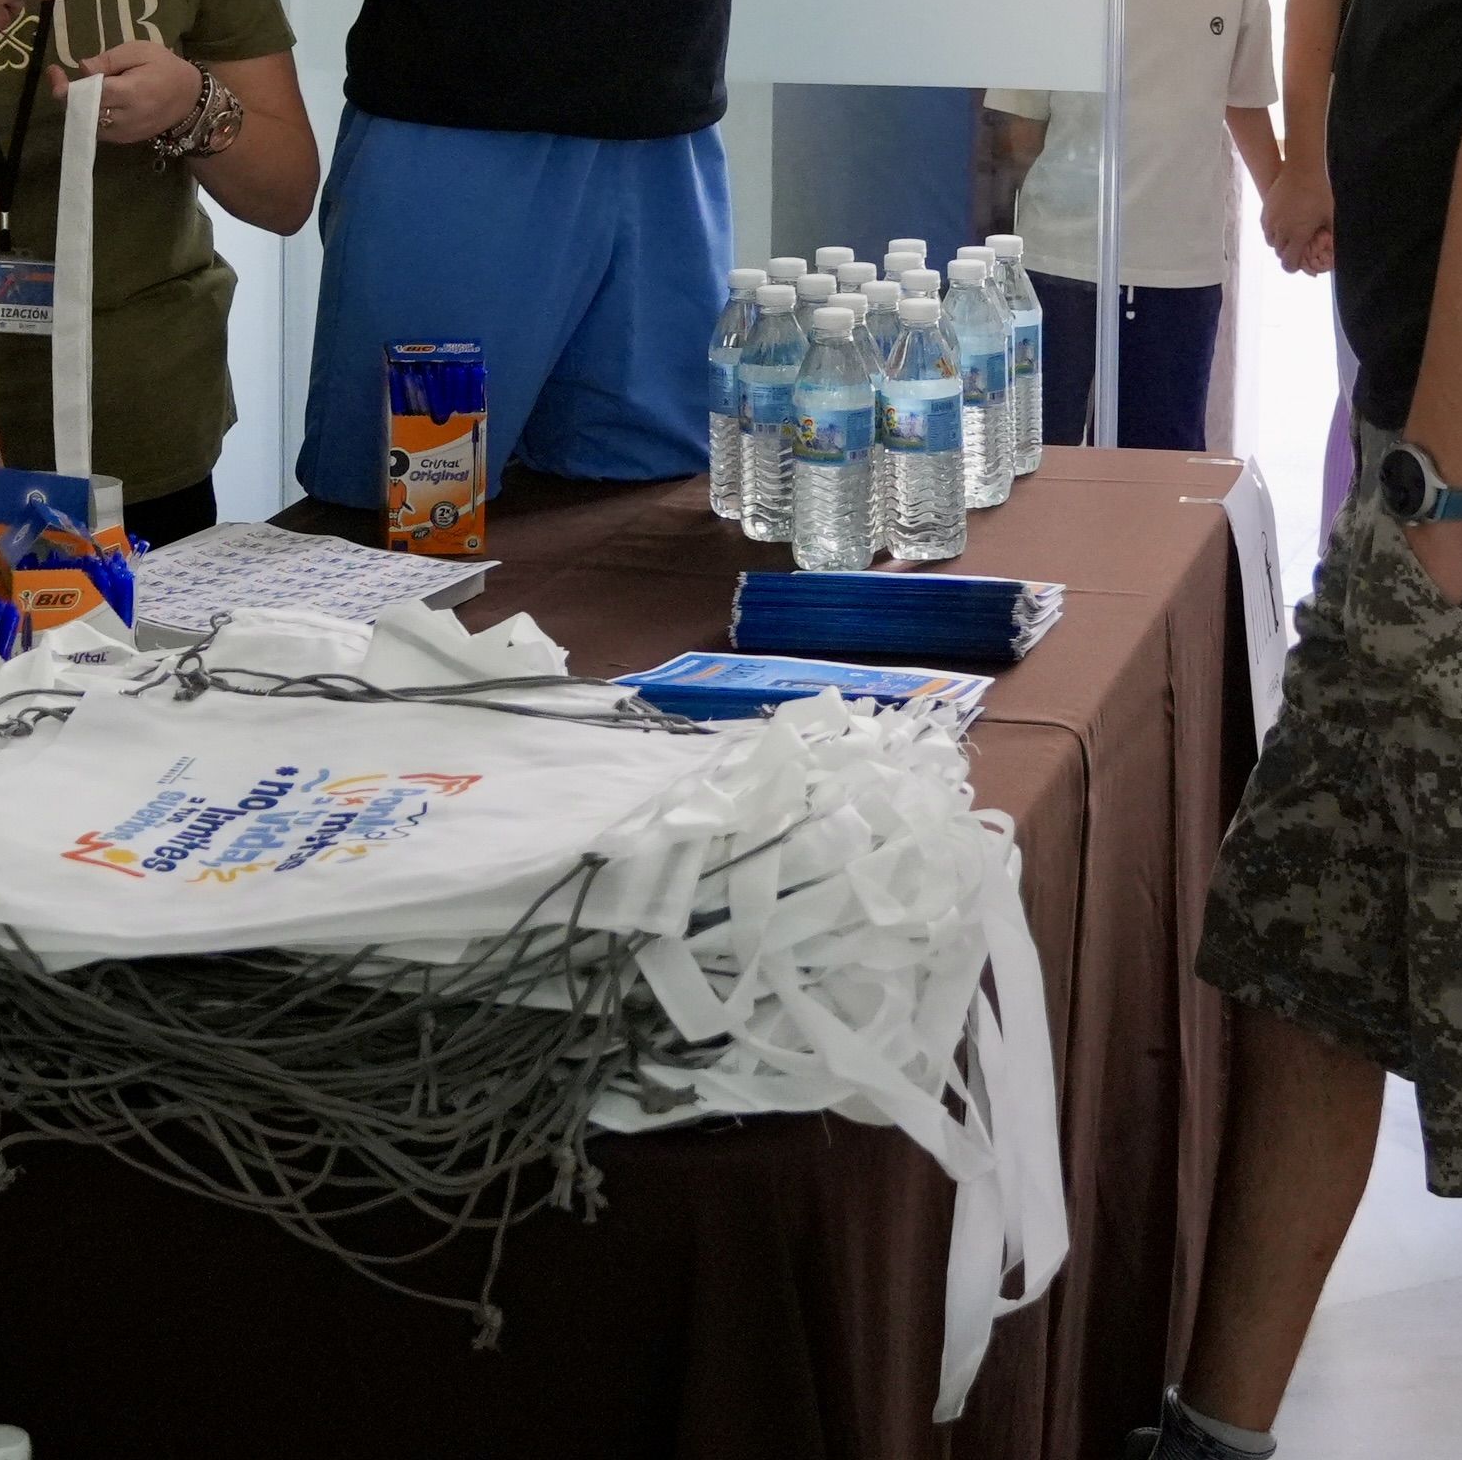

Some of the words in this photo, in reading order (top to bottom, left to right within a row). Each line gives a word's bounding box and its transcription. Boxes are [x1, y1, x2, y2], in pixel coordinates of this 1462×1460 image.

[420, 458, 460, 469] Cristal
[409, 469, 470, 486] Original
[35, 592, 76, 606] BIC
[237, 780, 295, 811] no
